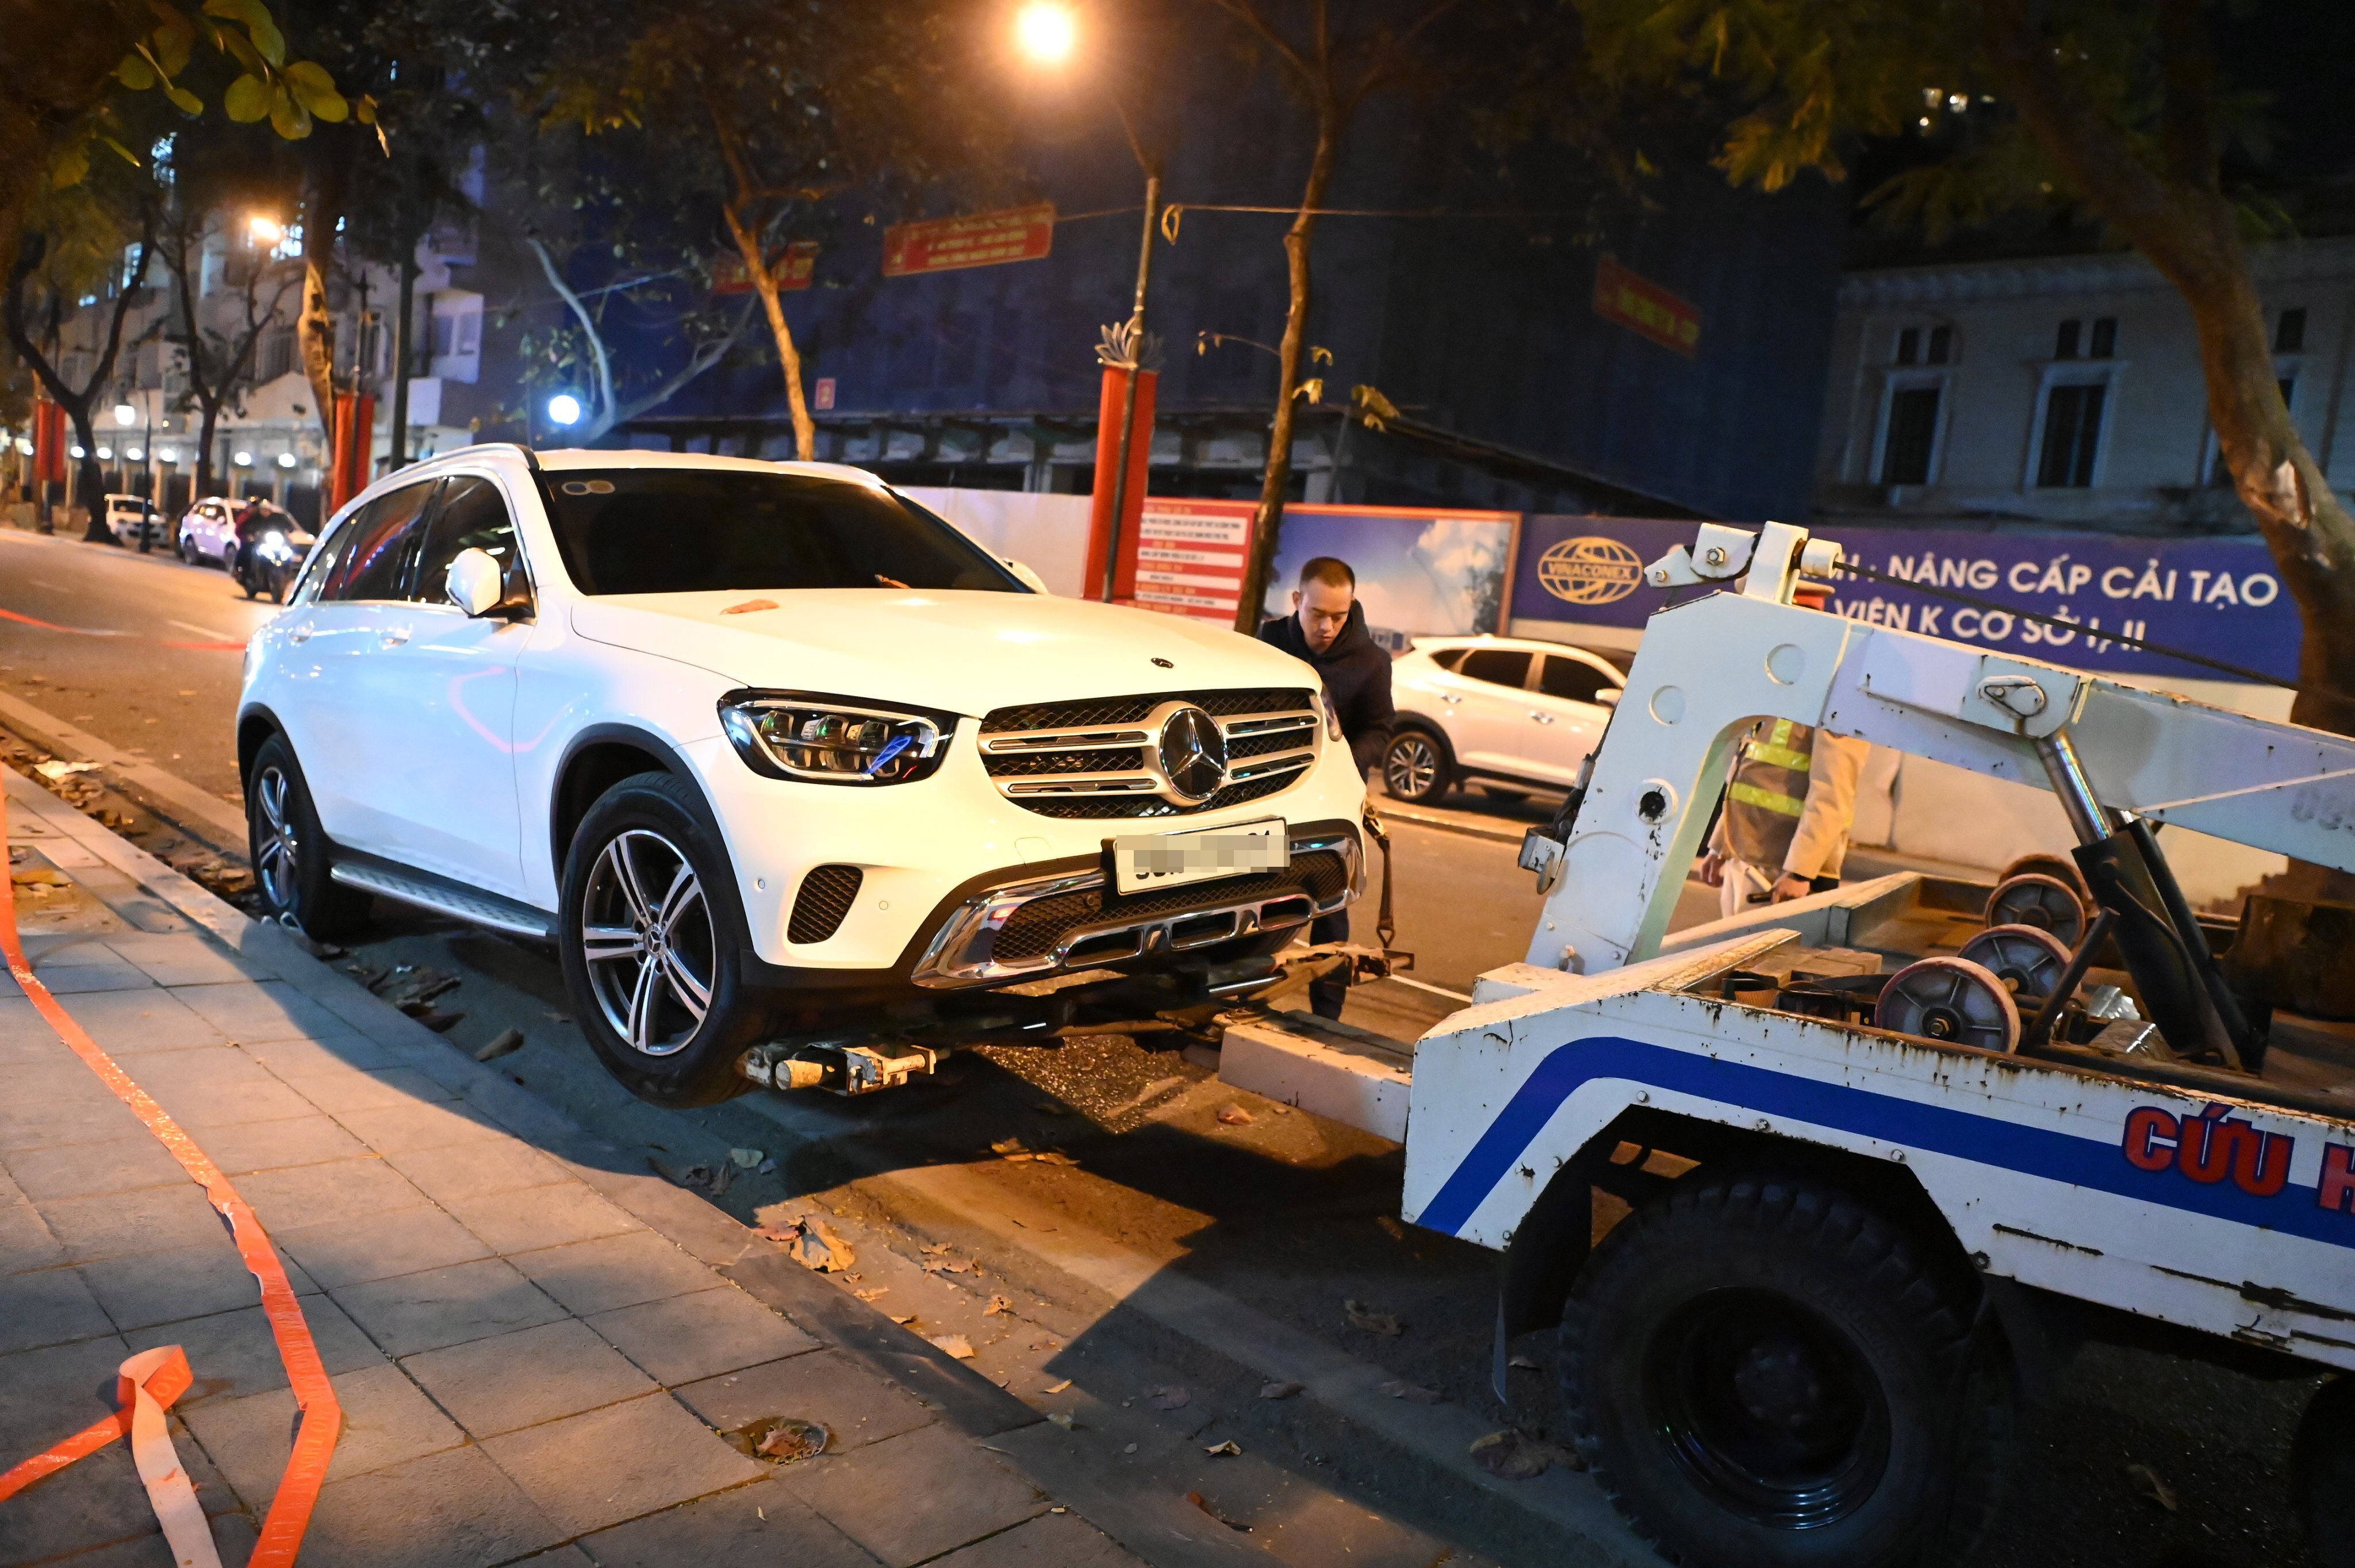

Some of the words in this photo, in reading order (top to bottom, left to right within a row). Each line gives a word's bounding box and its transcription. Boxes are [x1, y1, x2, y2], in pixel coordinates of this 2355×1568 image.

[1548, 561, 1632, 580] VINACONEX
[2009, 554, 2092, 595] CẤP
[2101, 558, 2178, 601] CẢI
[2189, 570, 2279, 610] TẠO
[1919, 605, 1944, 635] K
[1952, 608, 2016, 641] CƠ
[2021, 605, 2080, 646] SỞ
[2122, 1101, 2295, 1197] CỨU
